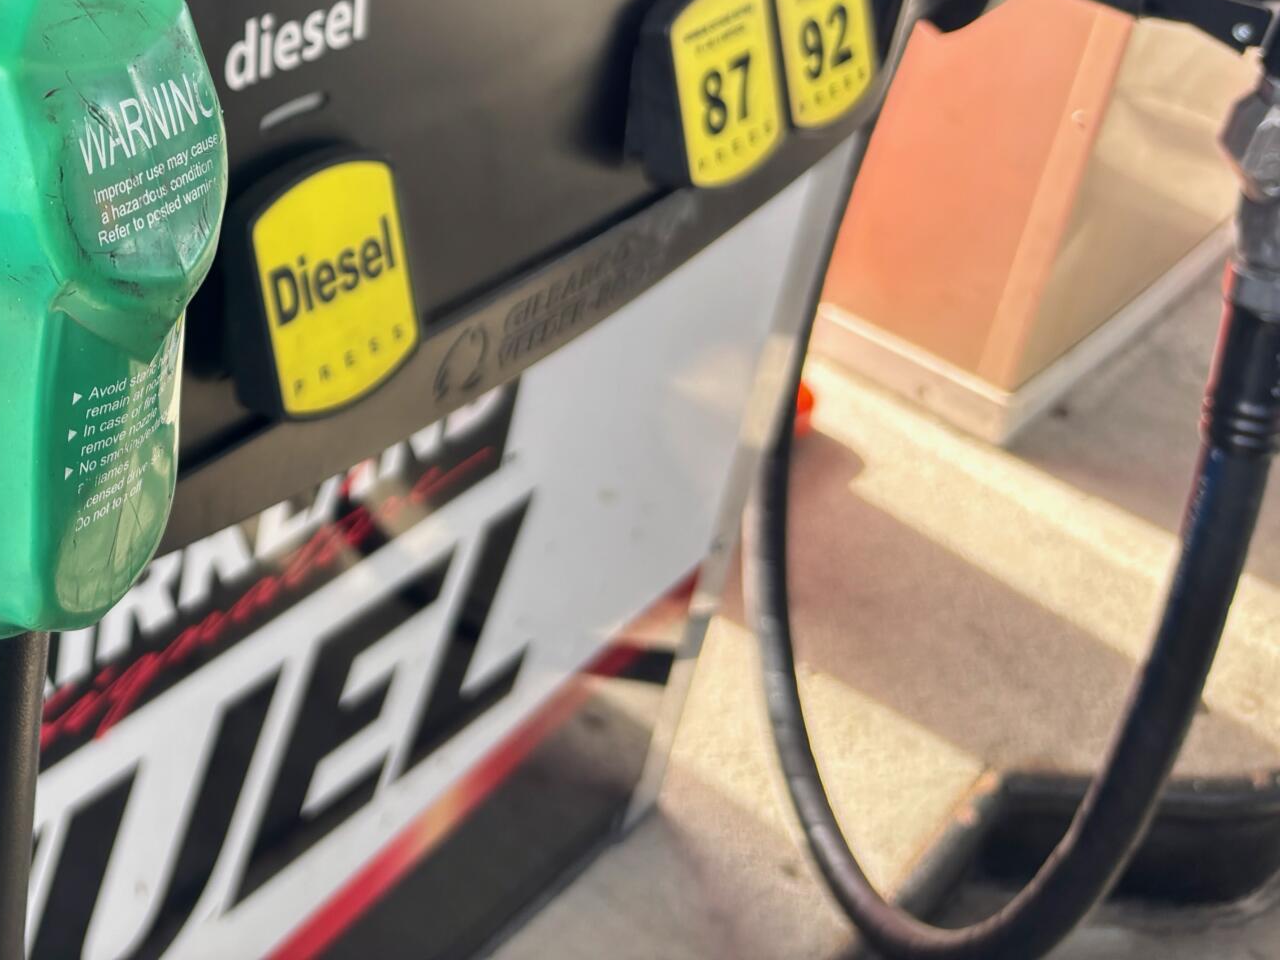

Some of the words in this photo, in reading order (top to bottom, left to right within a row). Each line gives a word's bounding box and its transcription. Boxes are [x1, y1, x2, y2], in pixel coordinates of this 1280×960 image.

[701, 50, 752, 136] 87
[801, 4, 854, 80] 92
[94, 171, 144, 205] Improper
[146, 162, 165, 181] use
[167, 150, 189, 172] may
[191, 133, 218, 158] cause
[101, 211, 110, 225] a
[111, 182, 168, 221] hazardous
[170, 158, 214, 192] condition
[98, 223, 131, 247] Refer
[132, 217, 145, 233] to
[146, 197, 182, 229] posted
[268, 213, 396, 327] Diesel
[85, 394, 130, 420] remain
[88, 378, 127, 401] Avoid
[81, 430, 127, 457] remove
[83, 424, 96, 438] In
[100, 413, 129, 432] case
[79, 459, 97, 476] No
[75, 516, 91, 532] Do
[93, 501, 110, 522] not
[25, 487, 536, 960] UEL
